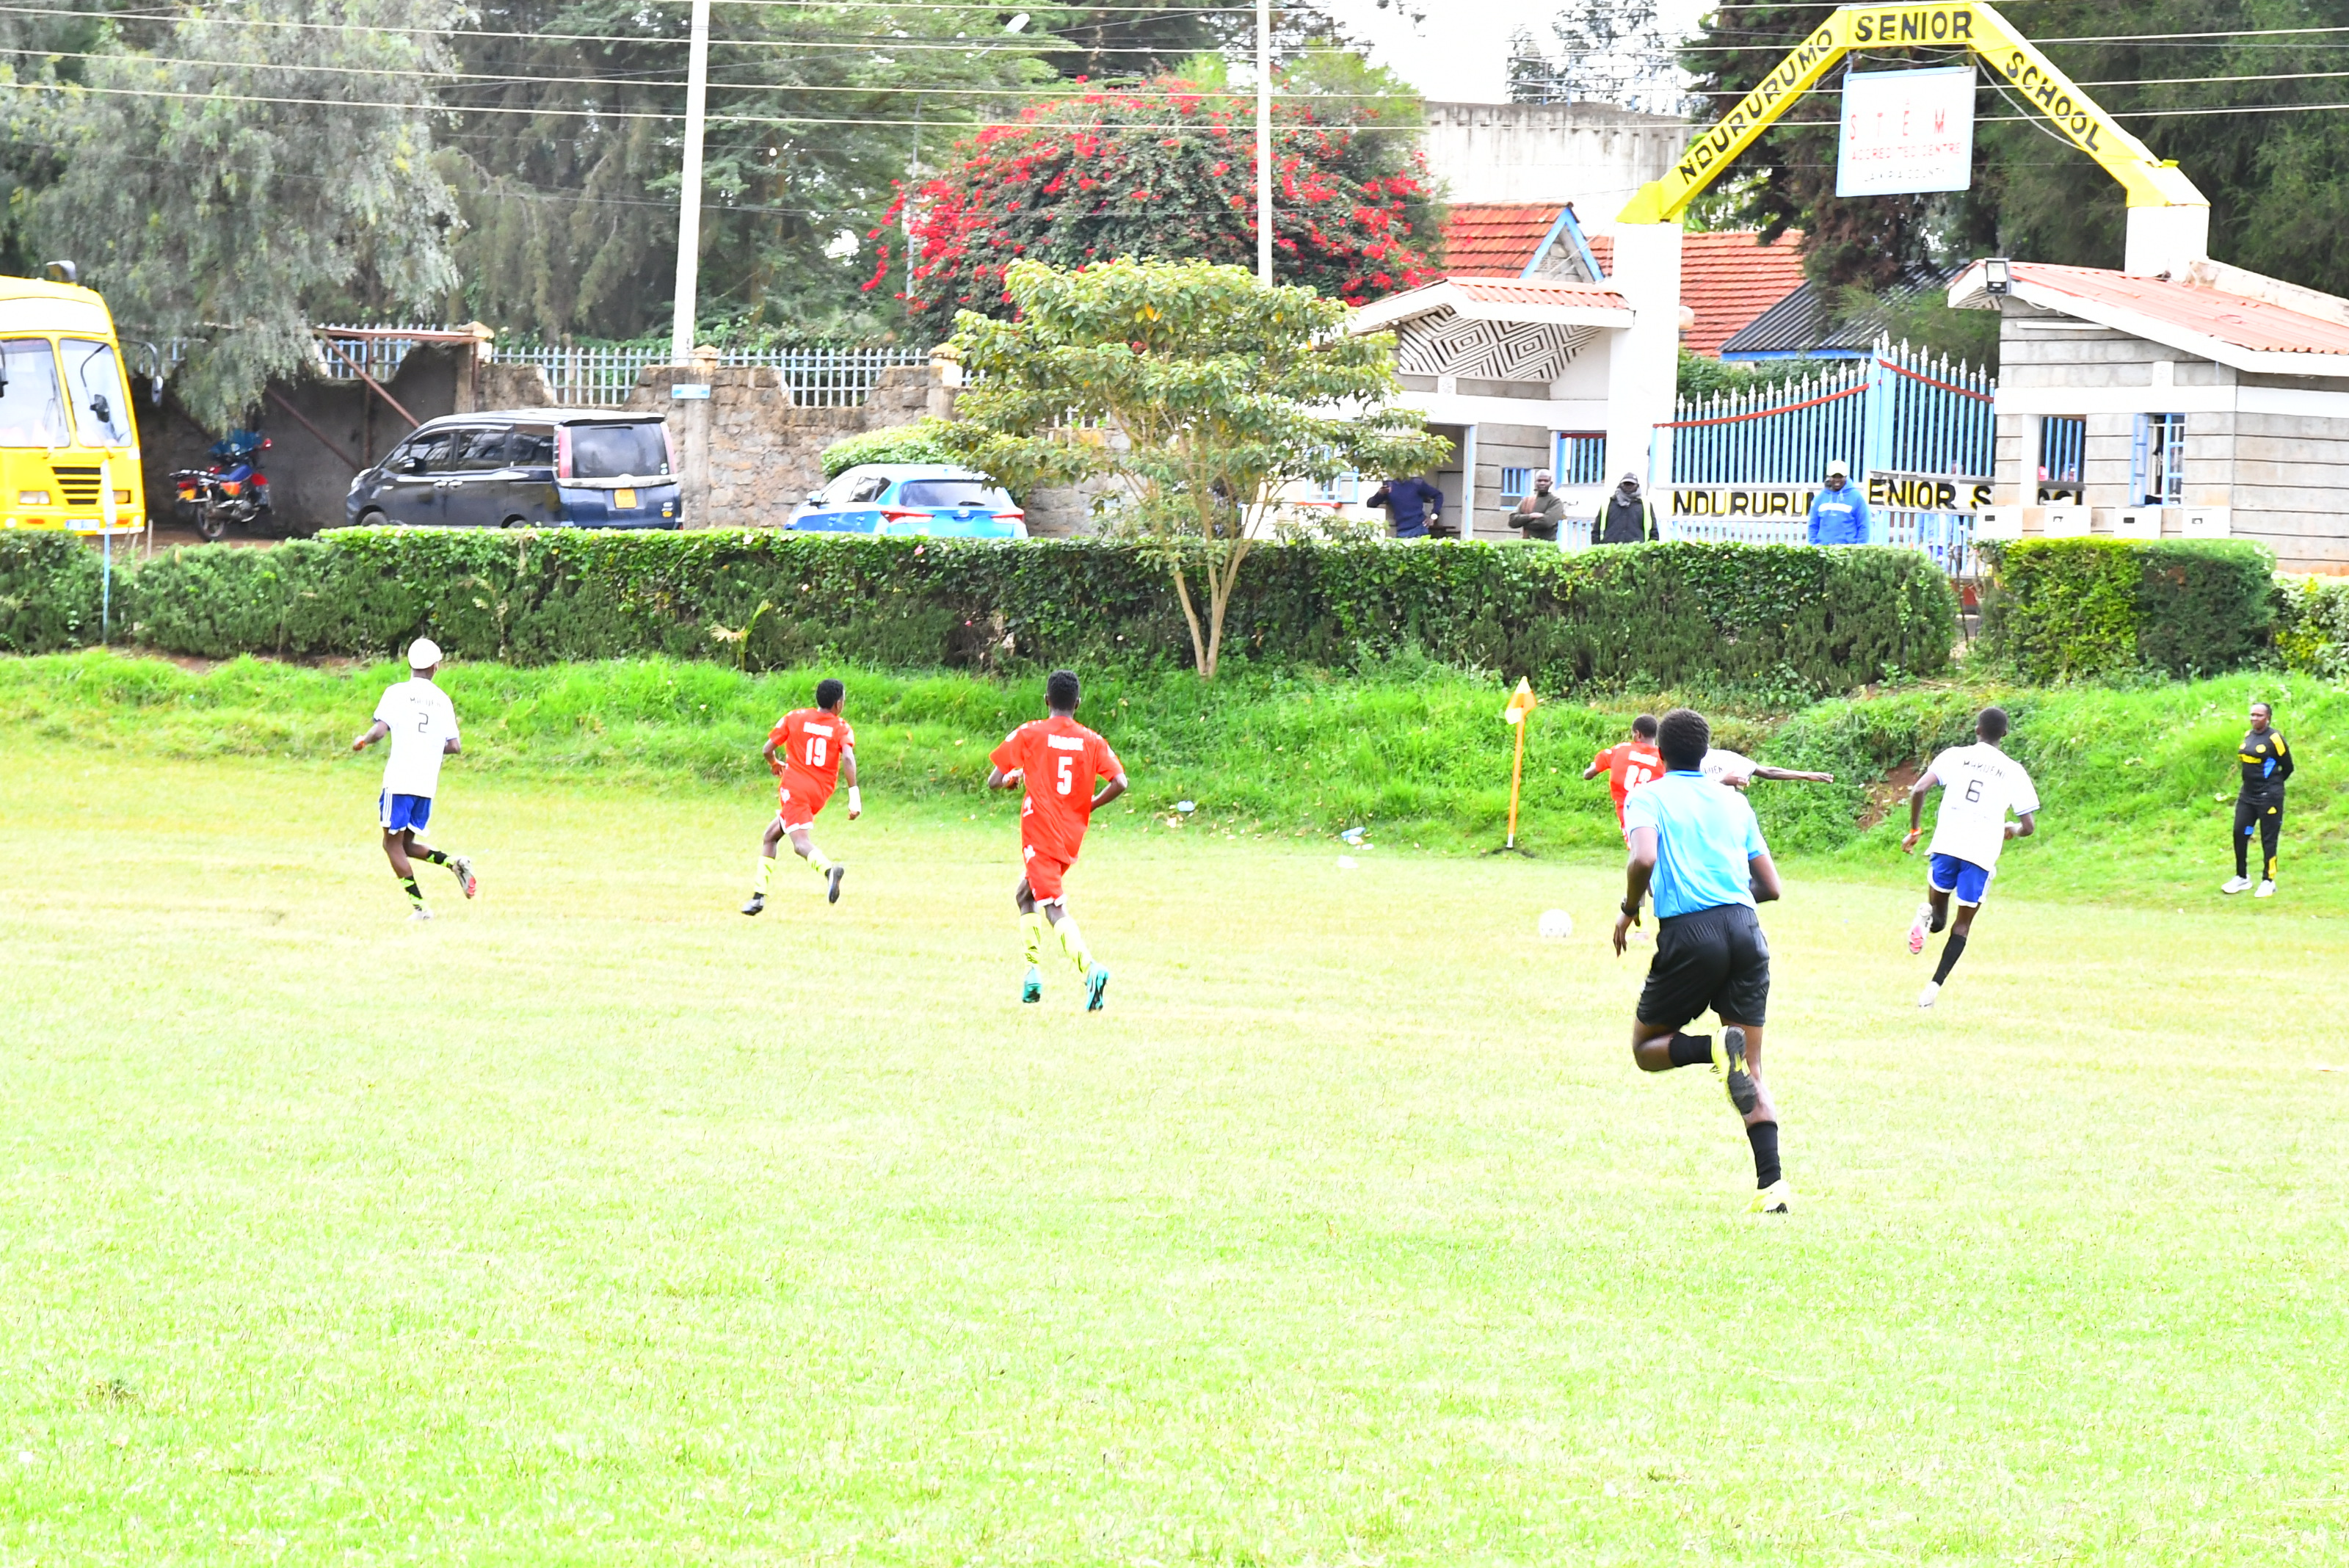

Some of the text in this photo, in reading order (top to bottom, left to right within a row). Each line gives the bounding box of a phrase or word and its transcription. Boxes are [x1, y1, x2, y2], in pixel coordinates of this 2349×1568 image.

[1680, 11, 2099, 185] NDURURUMO SENIOR SCHOOL
[1672, 491, 1814, 517] NDURURU
[1868, 478, 1956, 509] ENIOR
[418, 712, 429, 733] 2
[805, 737, 827, 767] 19
[1056, 756, 1072, 795] 5
[1965, 779, 1983, 803] 6
